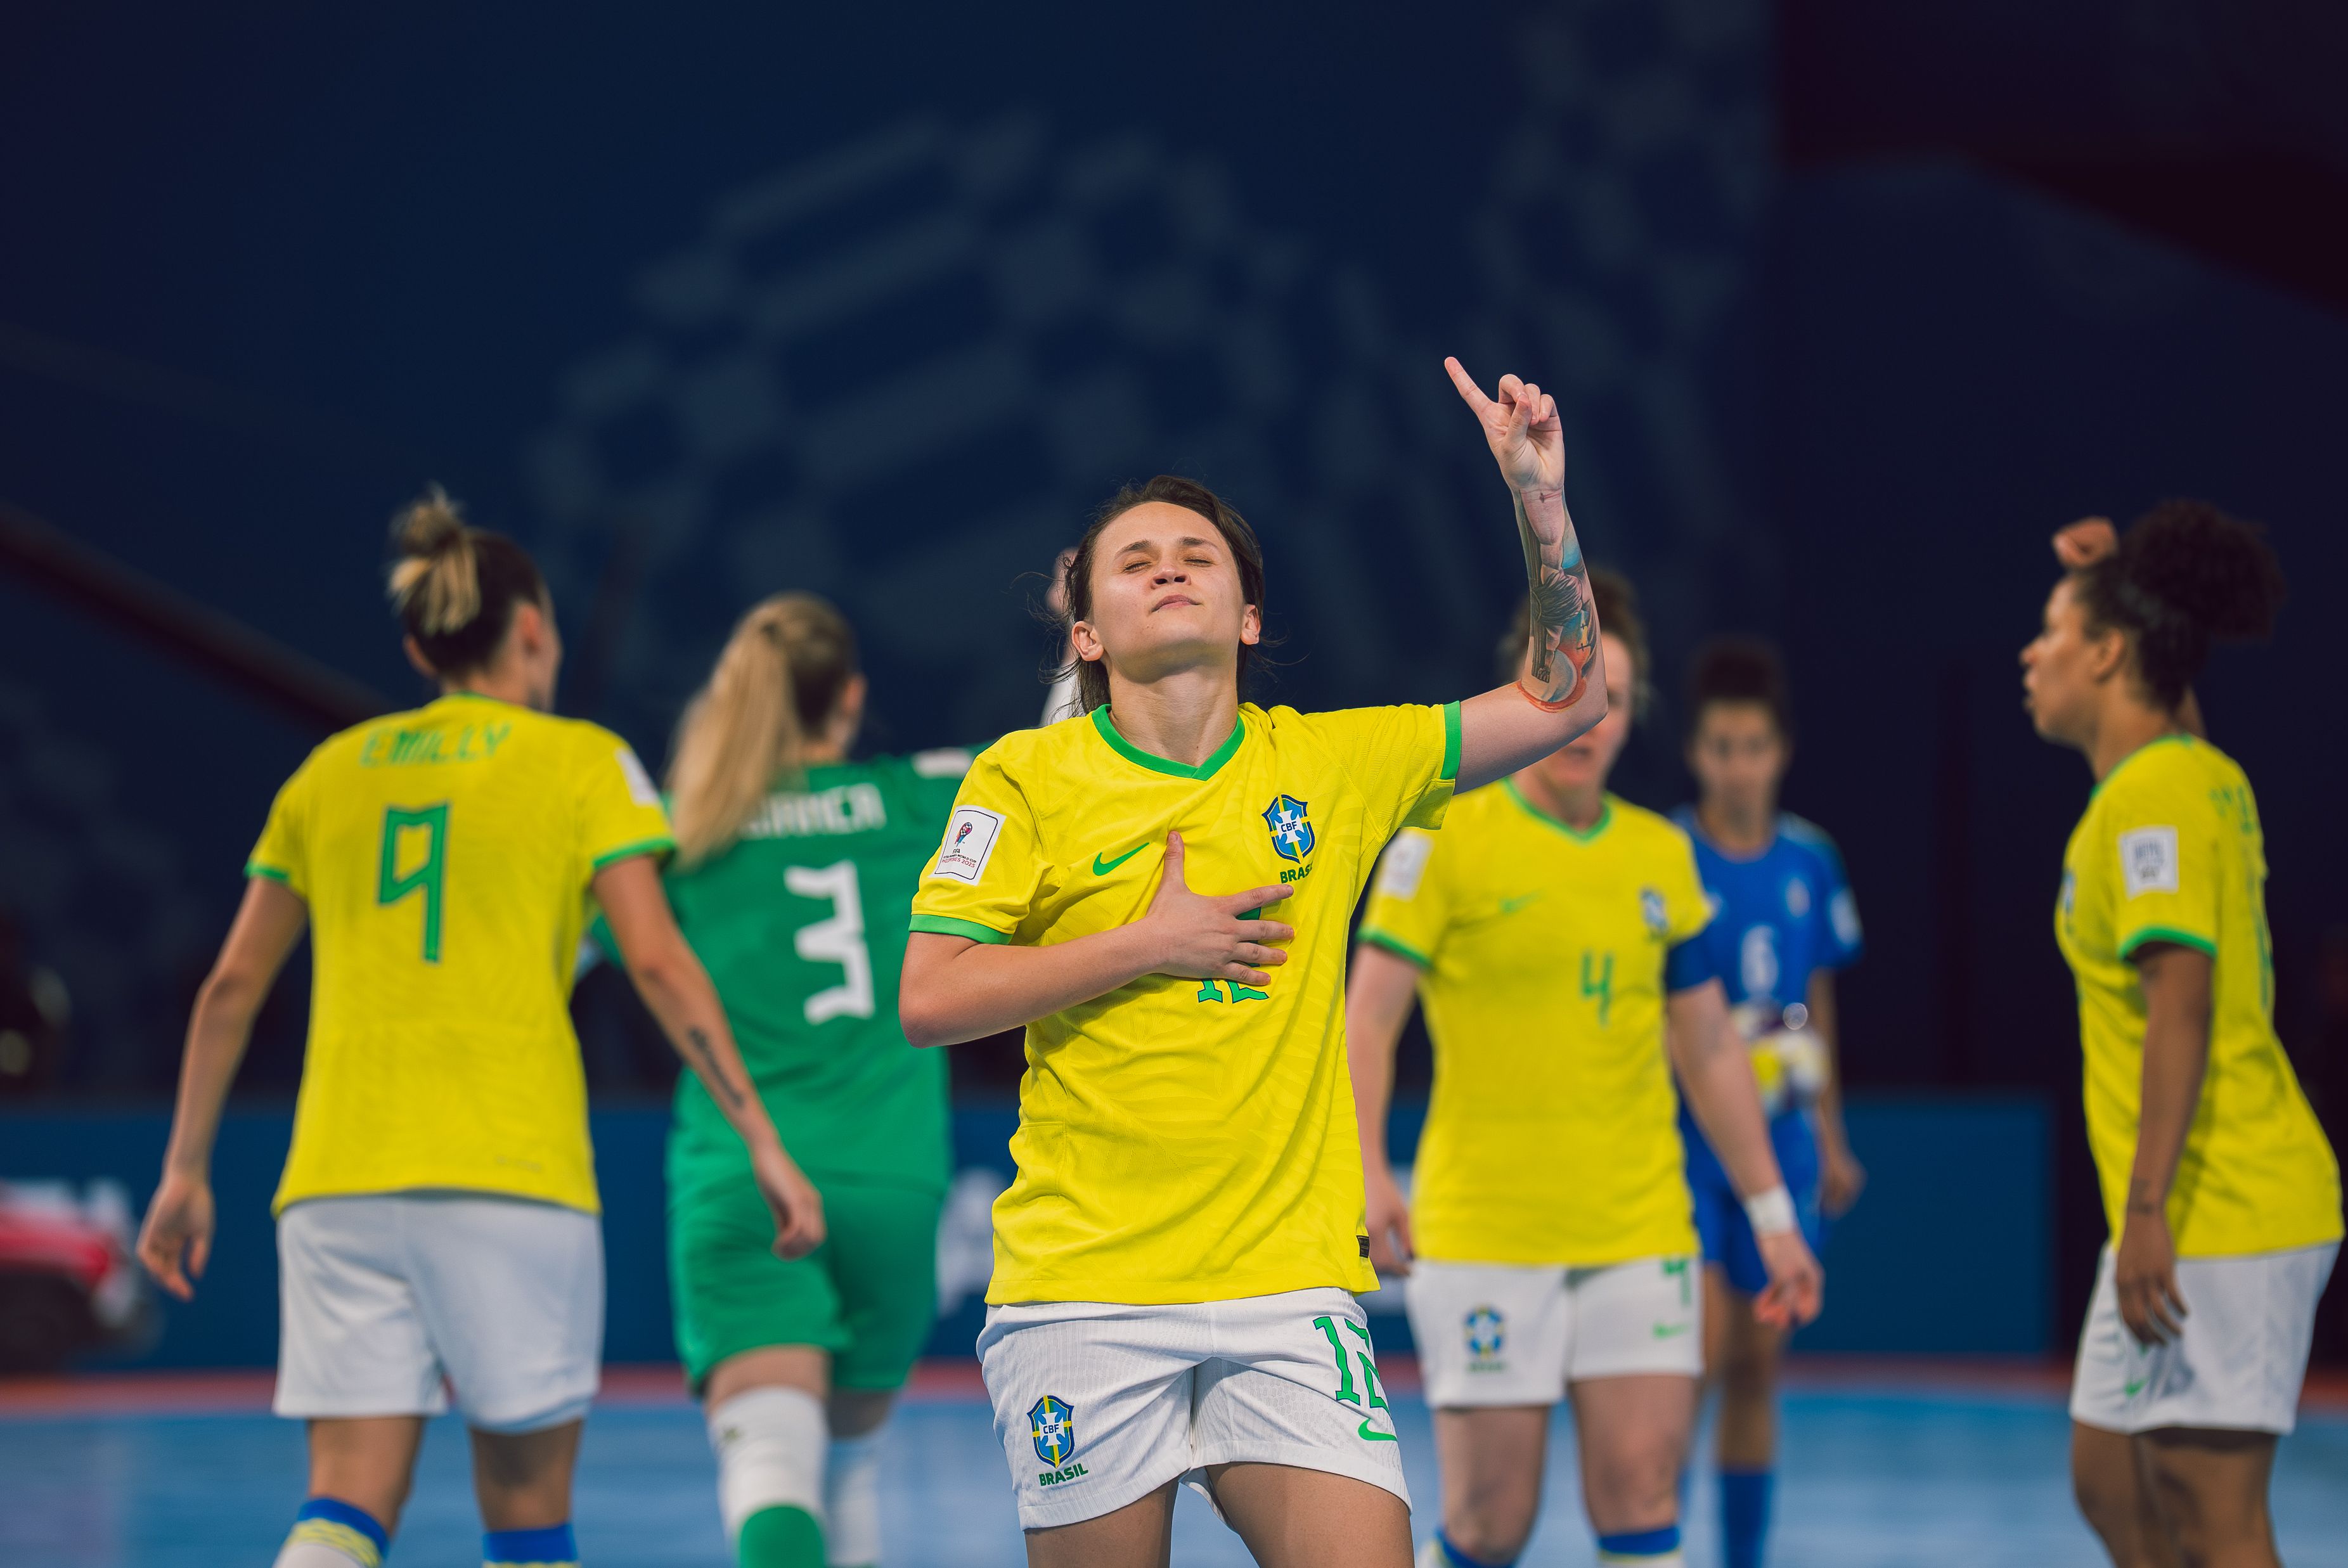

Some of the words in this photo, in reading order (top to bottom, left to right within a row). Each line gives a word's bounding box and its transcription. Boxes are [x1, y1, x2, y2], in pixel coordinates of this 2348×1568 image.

[360, 723, 511, 766] EMILLY
[1280, 821, 1297, 832] CBF
[378, 802, 449, 962] 9
[962, 859, 976, 868] 2025
[784, 860, 875, 1024] 3
[1580, 950, 1613, 1028] 4
[1313, 1316, 1390, 1416] 12
[1043, 1424, 1059, 1434] CBF
[1039, 1463, 1088, 1486] BRASIL
